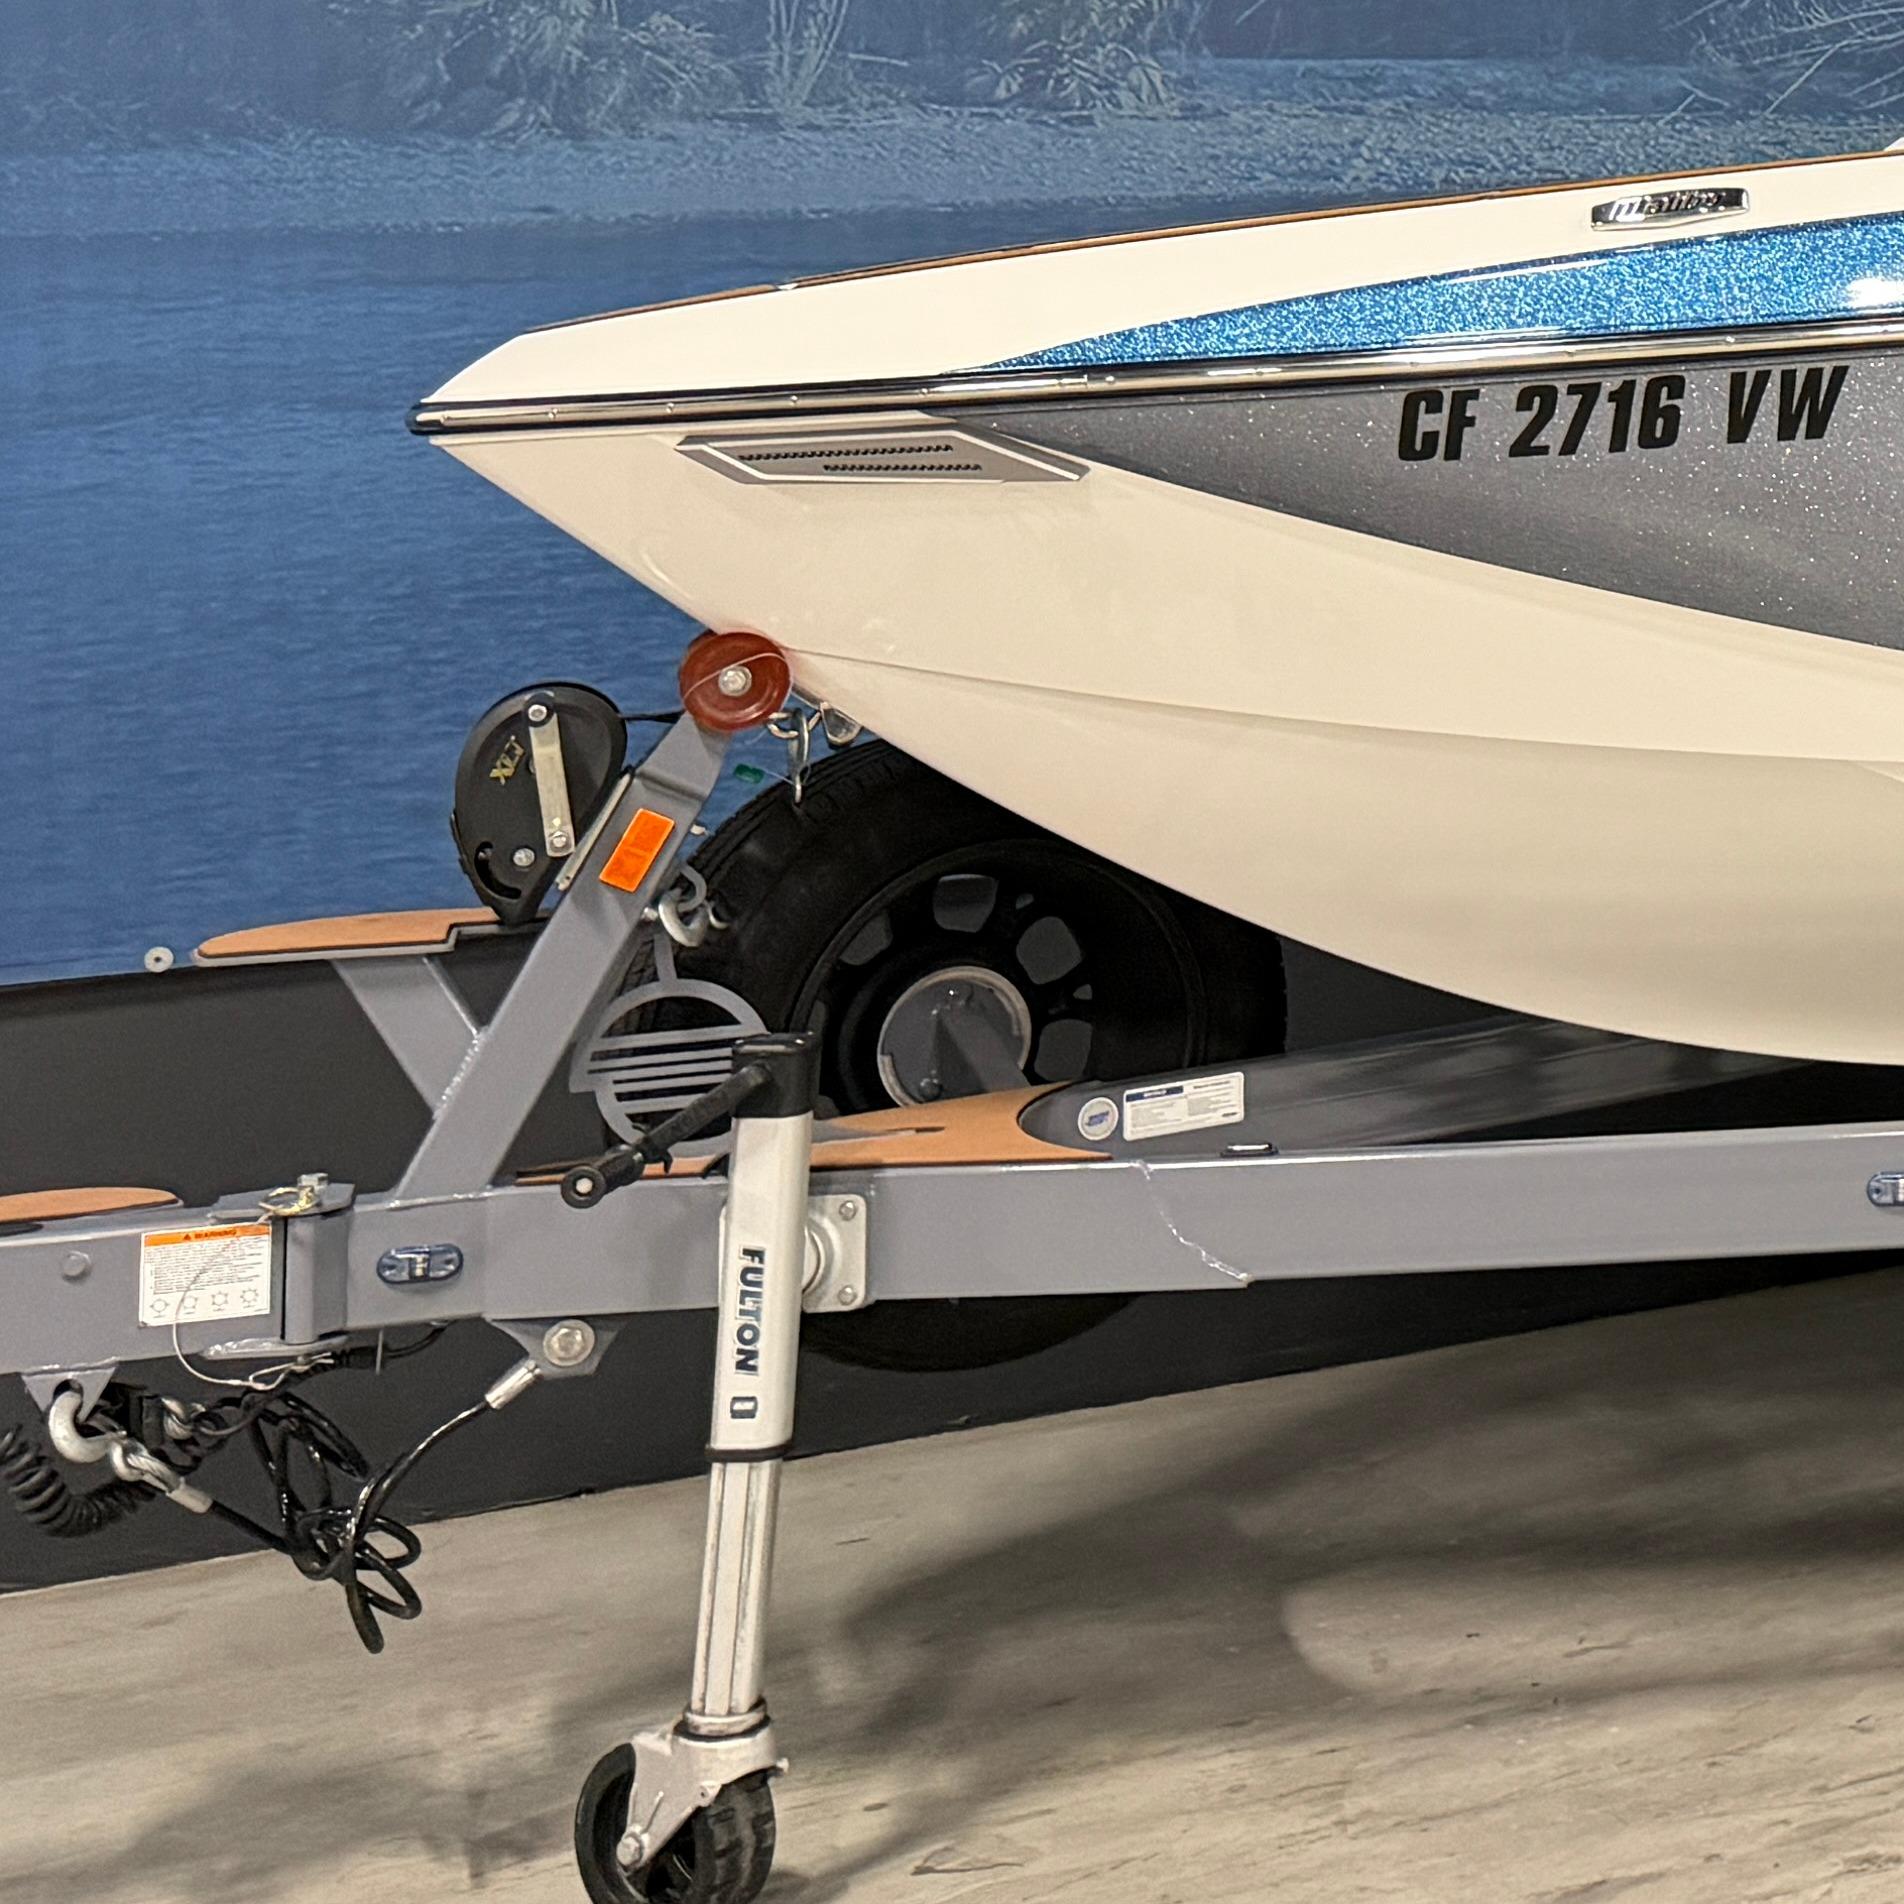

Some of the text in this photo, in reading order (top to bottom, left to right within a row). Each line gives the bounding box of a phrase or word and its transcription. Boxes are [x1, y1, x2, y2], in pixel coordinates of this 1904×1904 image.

[1399, 366, 1850, 462] CF 2716 VW
[735, 1246, 767, 1376] FULTON
